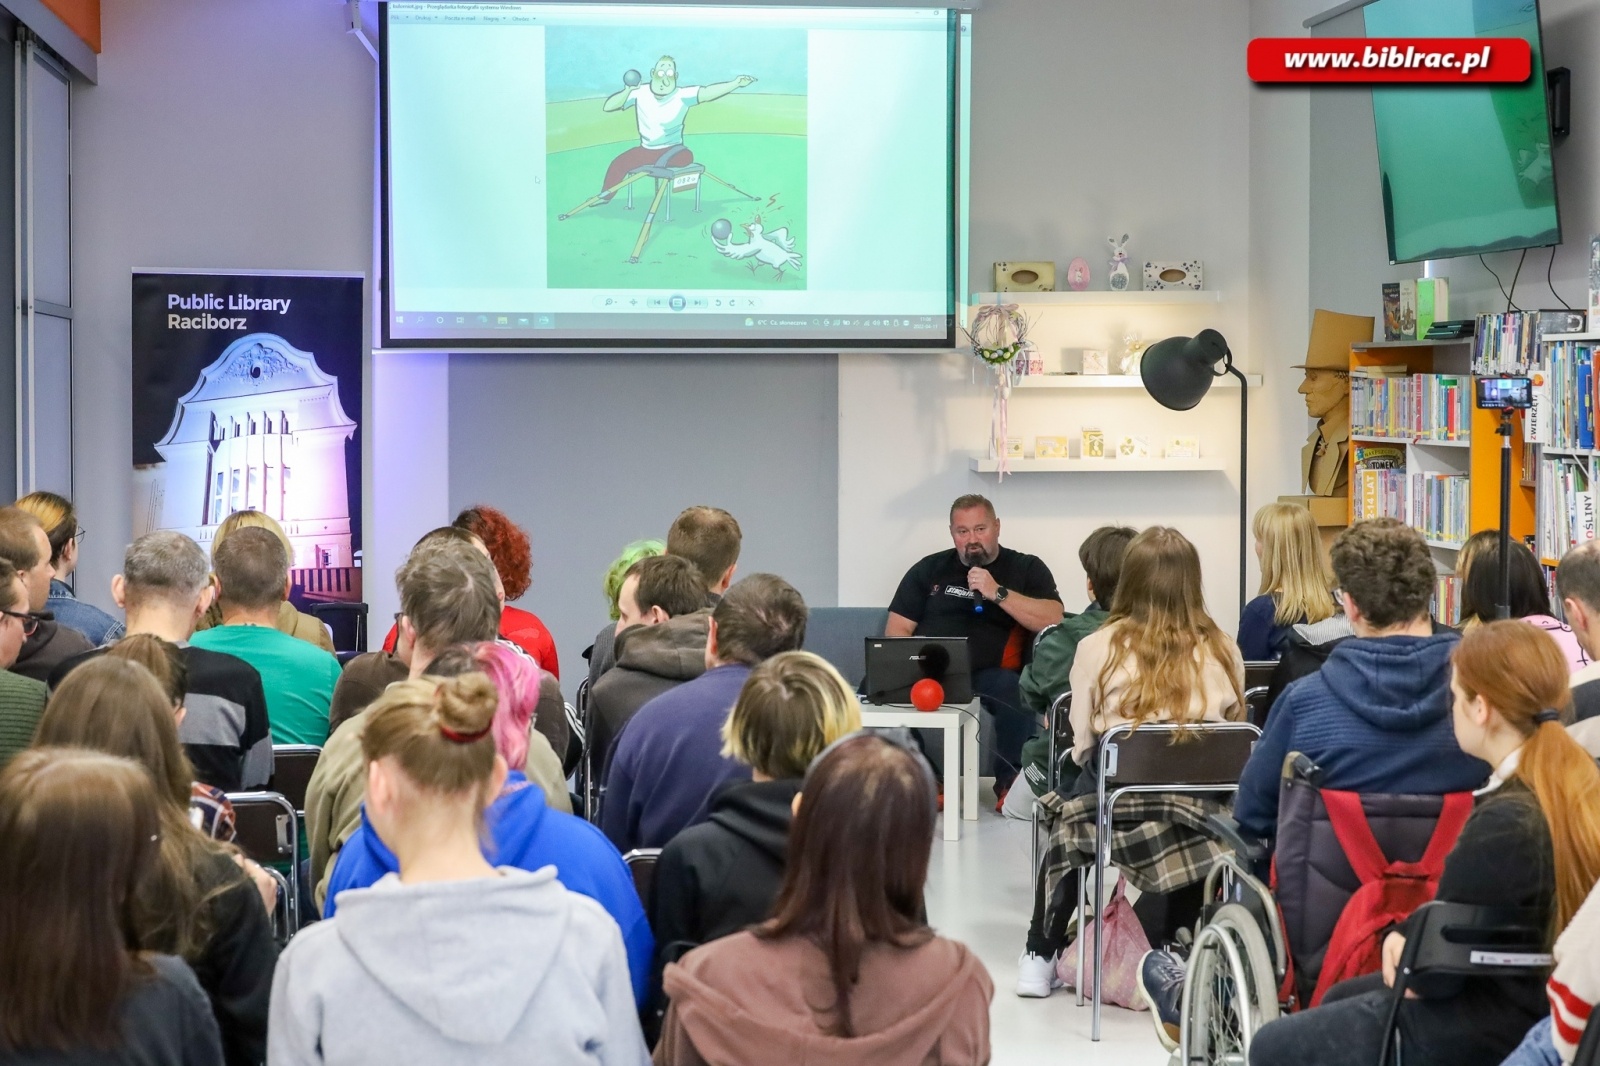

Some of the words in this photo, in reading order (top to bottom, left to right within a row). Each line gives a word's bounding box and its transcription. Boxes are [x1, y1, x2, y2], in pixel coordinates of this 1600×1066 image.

[168, 293, 224, 310] Public
[228, 294, 291, 315] Library
[168, 313, 247, 330] Raciborz
[1371, 461, 1394, 469] TOMEK
[1366, 475, 1375, 495] LAT
[1366, 497, 1375, 519] 2-14
[1582, 495, 1594, 540] OŚLINY
